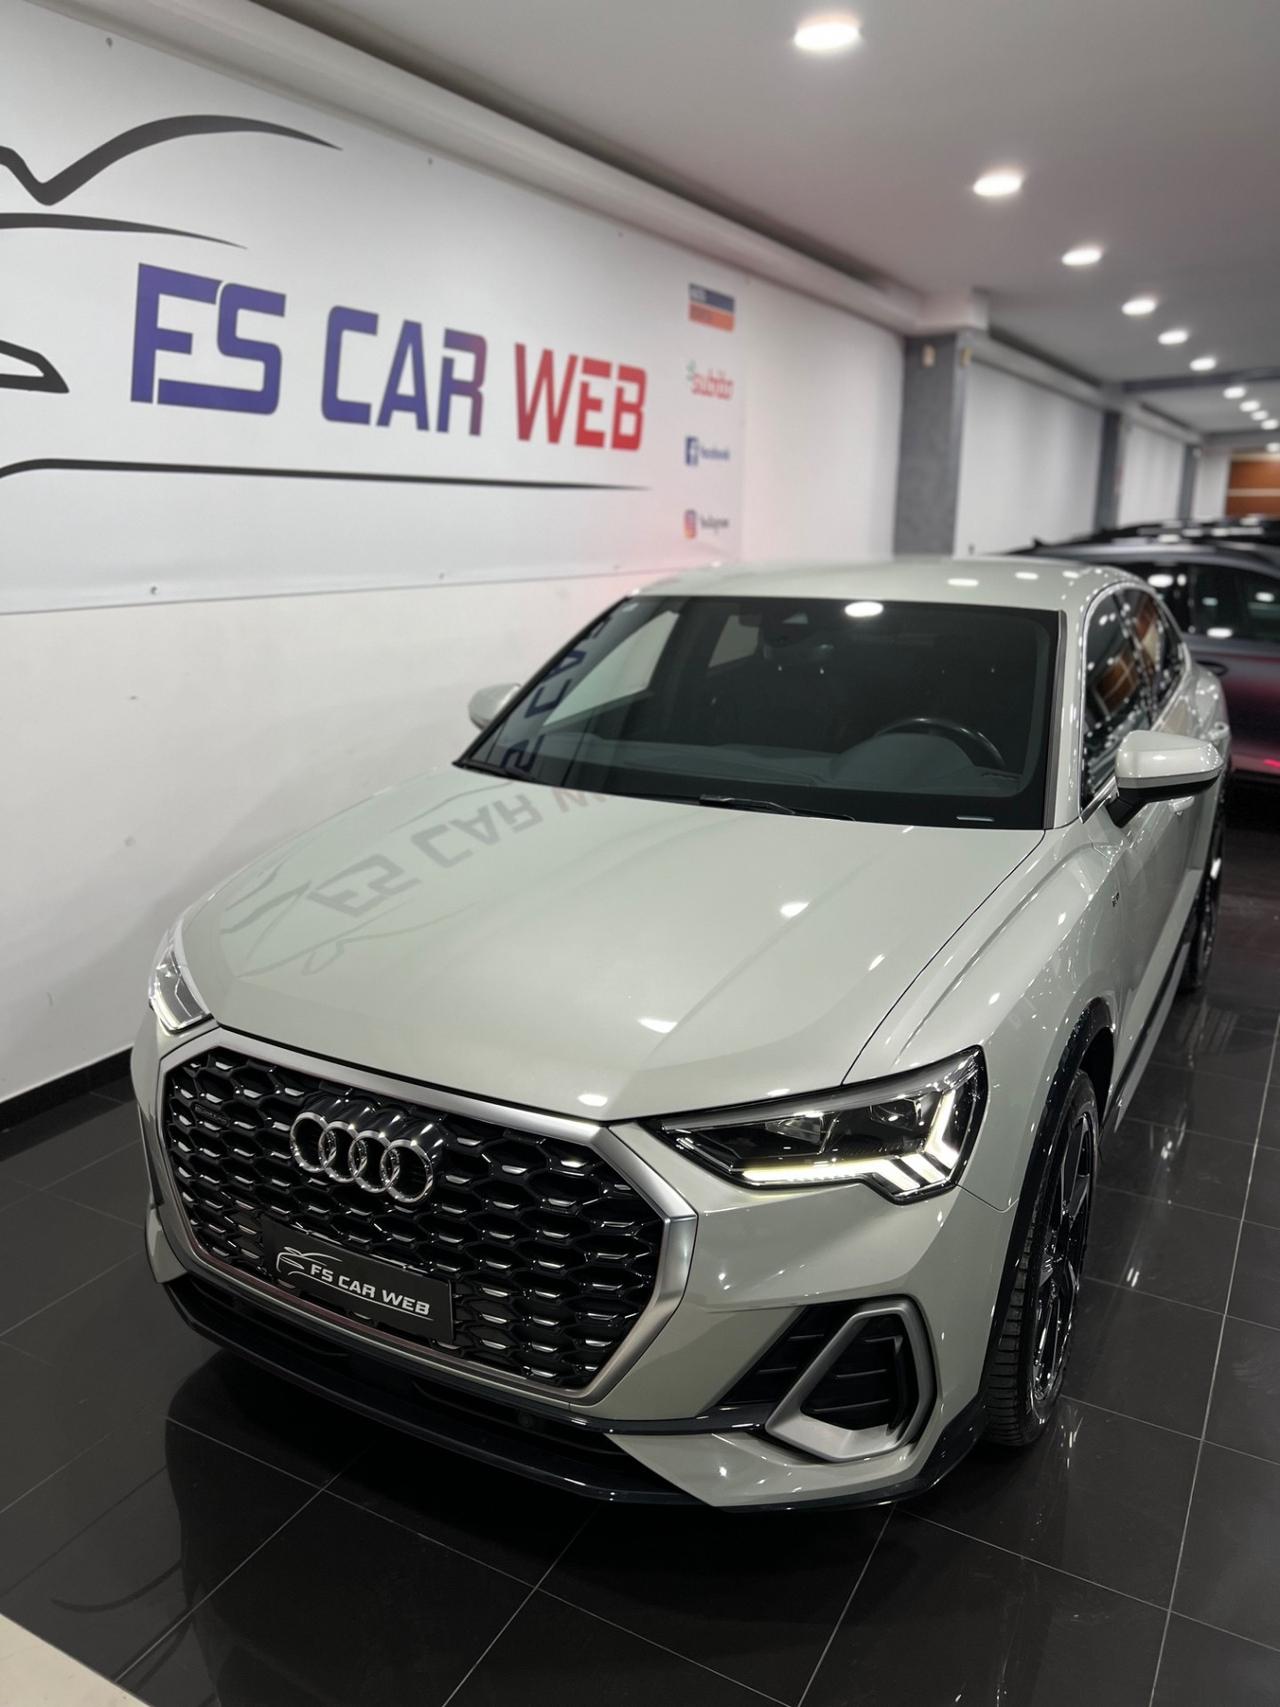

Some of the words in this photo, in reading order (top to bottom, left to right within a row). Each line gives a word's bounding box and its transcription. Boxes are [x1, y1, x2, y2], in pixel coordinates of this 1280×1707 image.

[321, 305, 488, 437] CAR
[514, 342, 648, 452] WEB
[310, 1263, 334, 1283] FS
[338, 1275, 376, 1299] CAR
[382, 1289, 431, 1316] WEB
